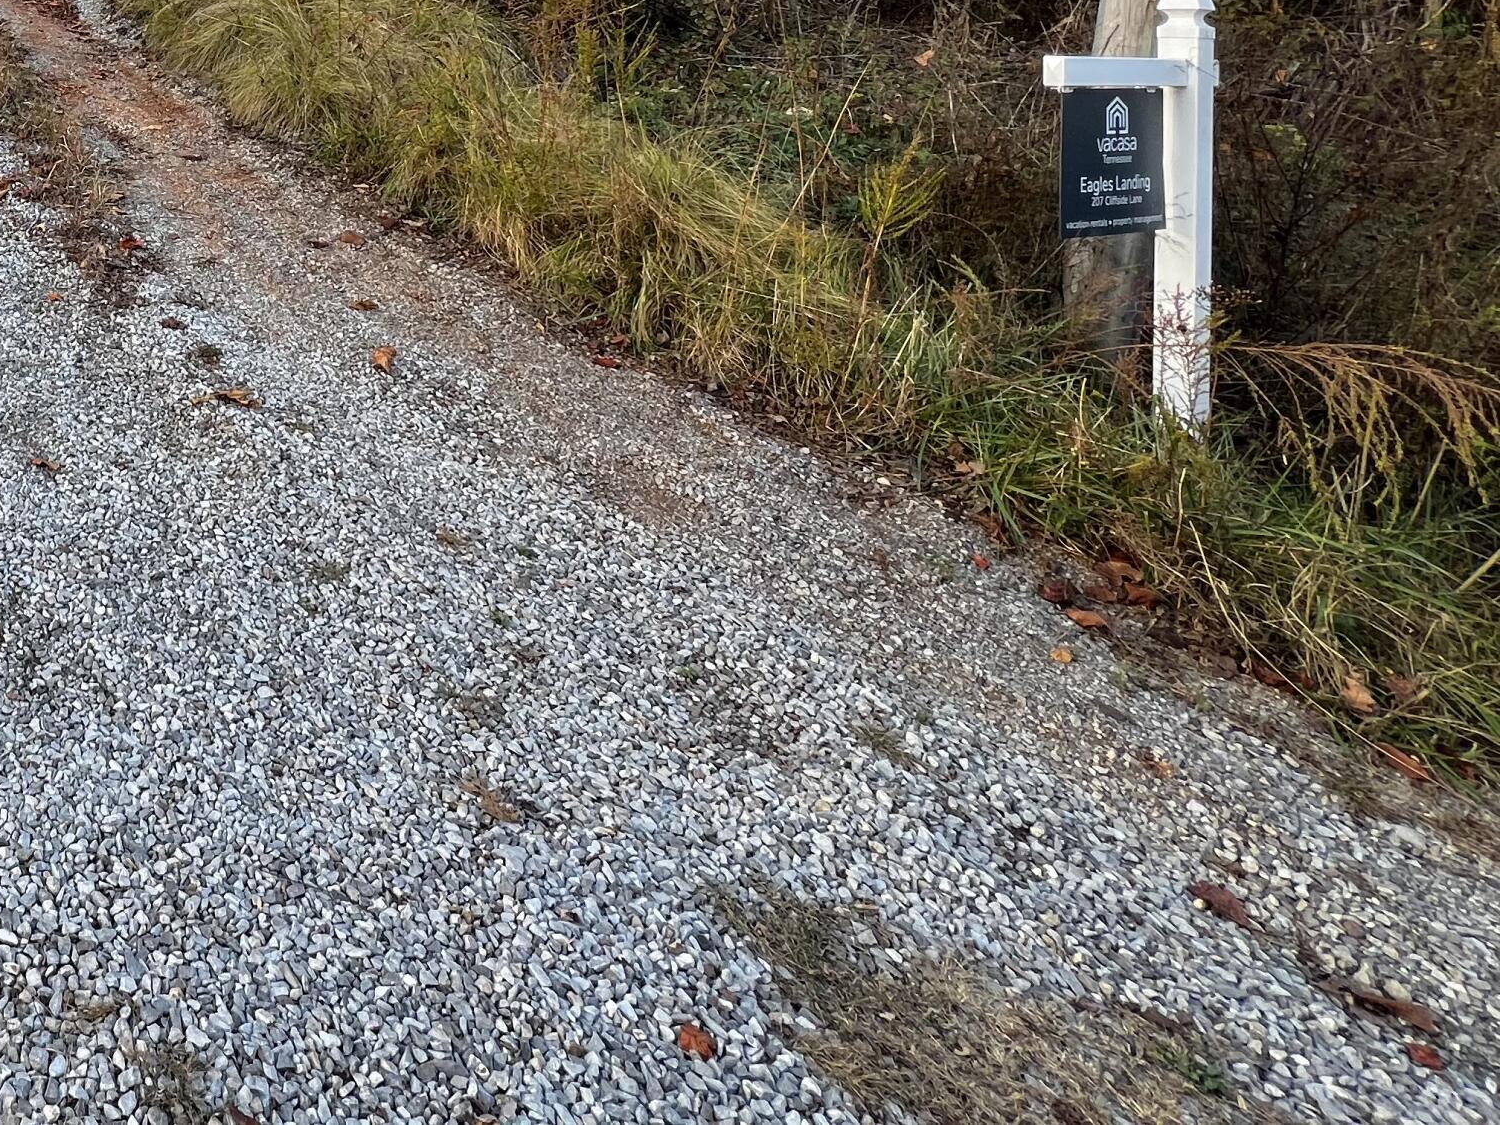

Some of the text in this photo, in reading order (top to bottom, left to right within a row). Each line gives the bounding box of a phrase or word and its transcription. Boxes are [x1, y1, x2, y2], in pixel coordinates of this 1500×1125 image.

[1096, 137, 1138, 152] vacasa
[1080, 174, 1151, 196] Eagles Landing
[1105, 195, 1128, 206] Cliffside
